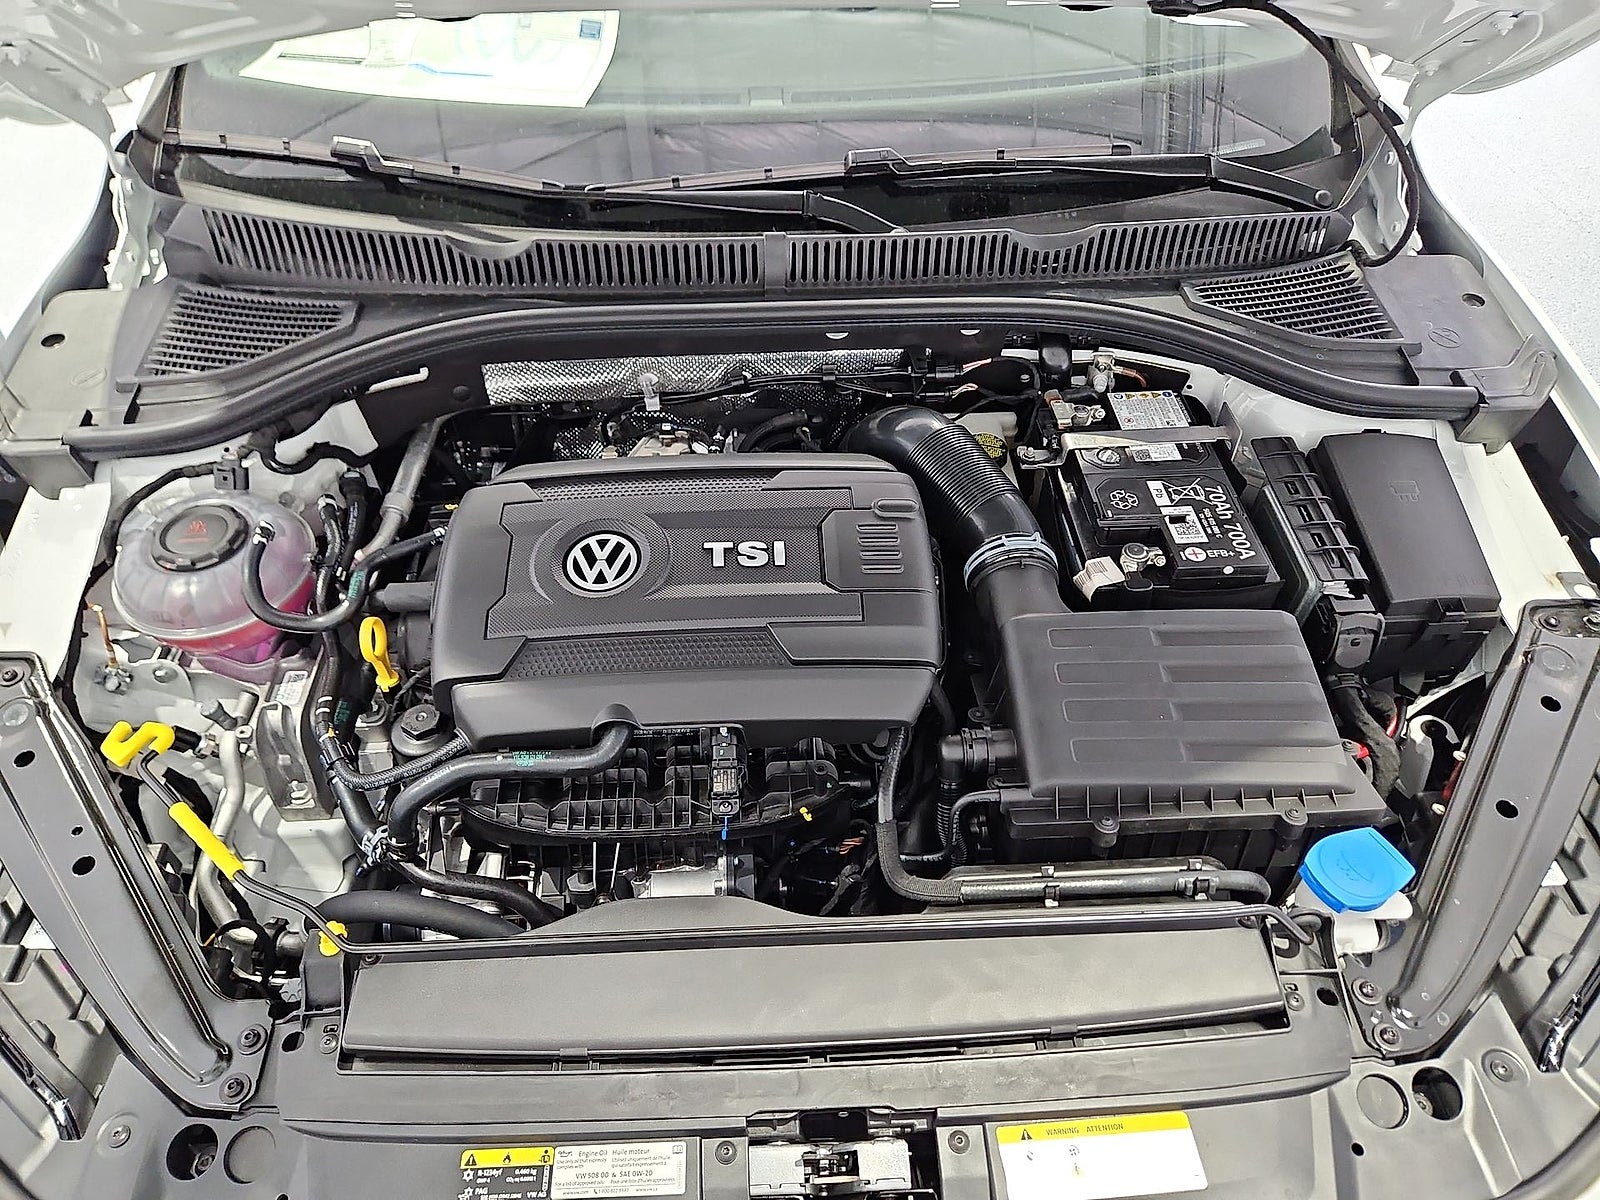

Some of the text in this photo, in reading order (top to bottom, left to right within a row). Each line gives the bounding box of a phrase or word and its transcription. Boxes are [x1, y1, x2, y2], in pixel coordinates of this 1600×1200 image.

[1205, 485, 1235, 520] 70Ah
[1223, 522, 1256, 560] 700A
[703, 540, 786, 567] TSI
[1206, 549, 1236, 558] EFB+
[1046, 1122, 1124, 1136] WARNING ATTENTION
[579, 1150, 598, 1158] Engine
[619, 1170, 631, 1178] SAE
[632, 1169, 653, 1177] 0W-20
[475, 1187, 489, 1195] PAG
